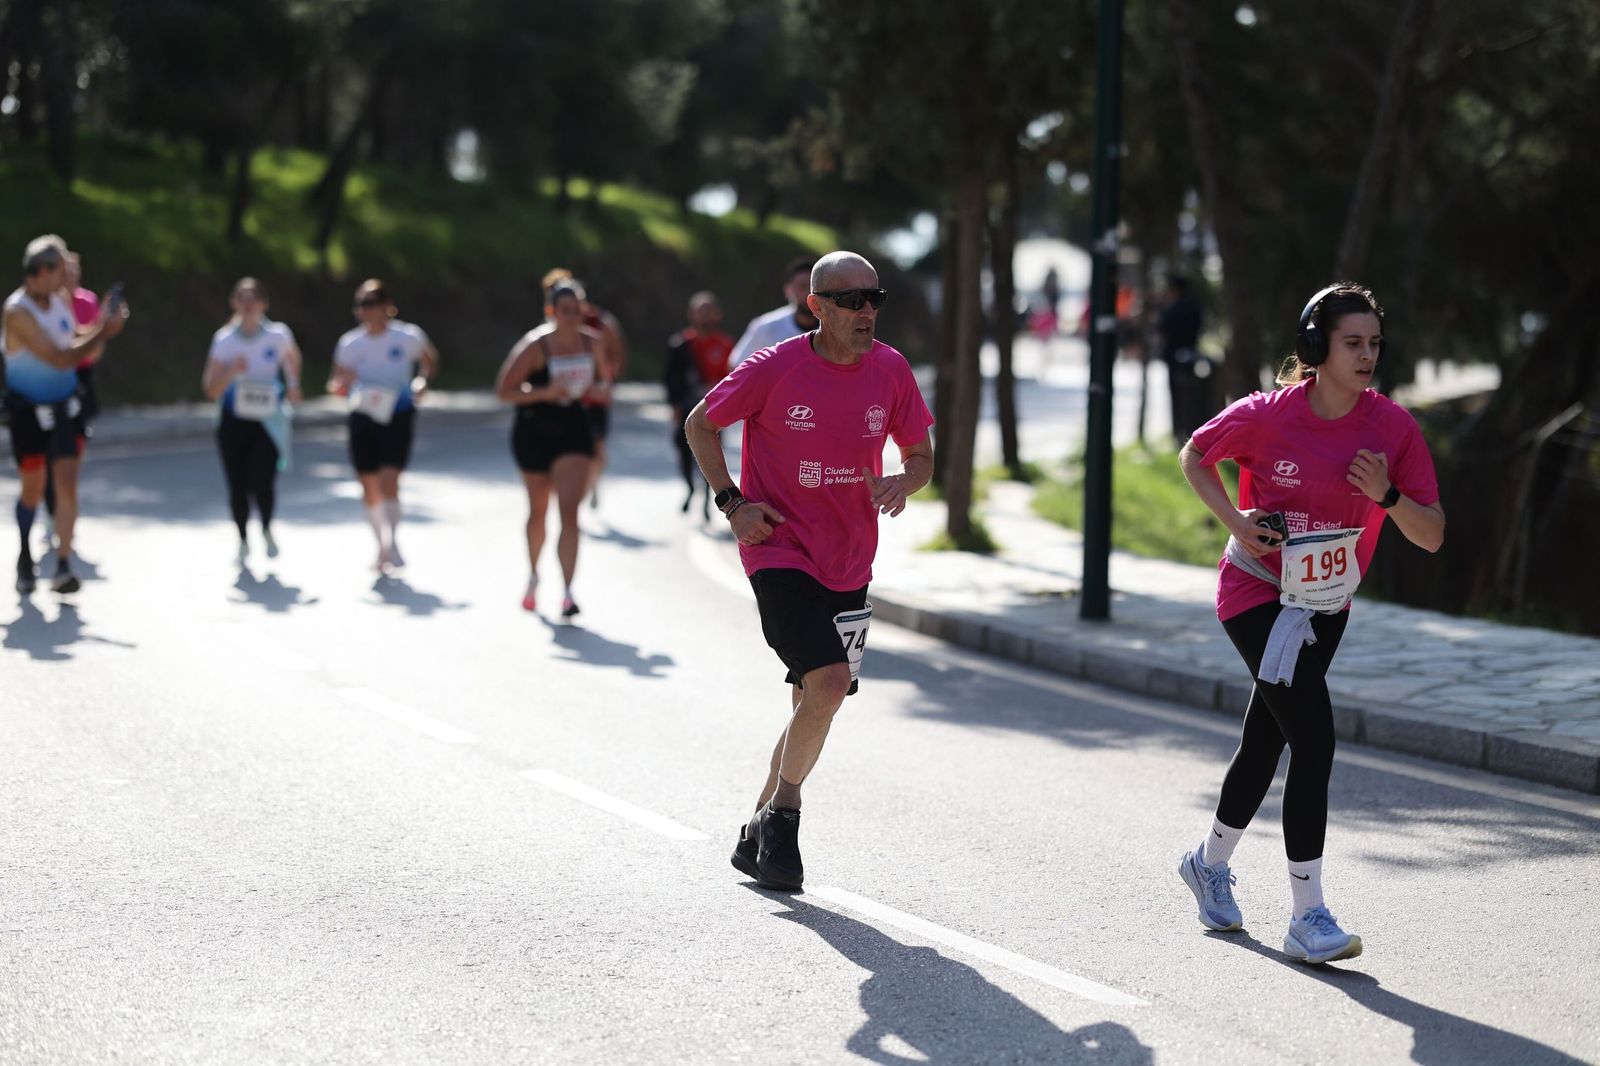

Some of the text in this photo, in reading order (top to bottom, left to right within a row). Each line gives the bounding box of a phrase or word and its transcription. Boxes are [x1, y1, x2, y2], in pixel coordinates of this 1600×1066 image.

[785, 419, 815, 429] HYUNDAI
[824, 467, 855, 475] Ciudad
[835, 475, 864, 484] Málaga
[1271, 474, 1301, 486] HYUNDAI
[1301, 547, 1347, 582] 199
